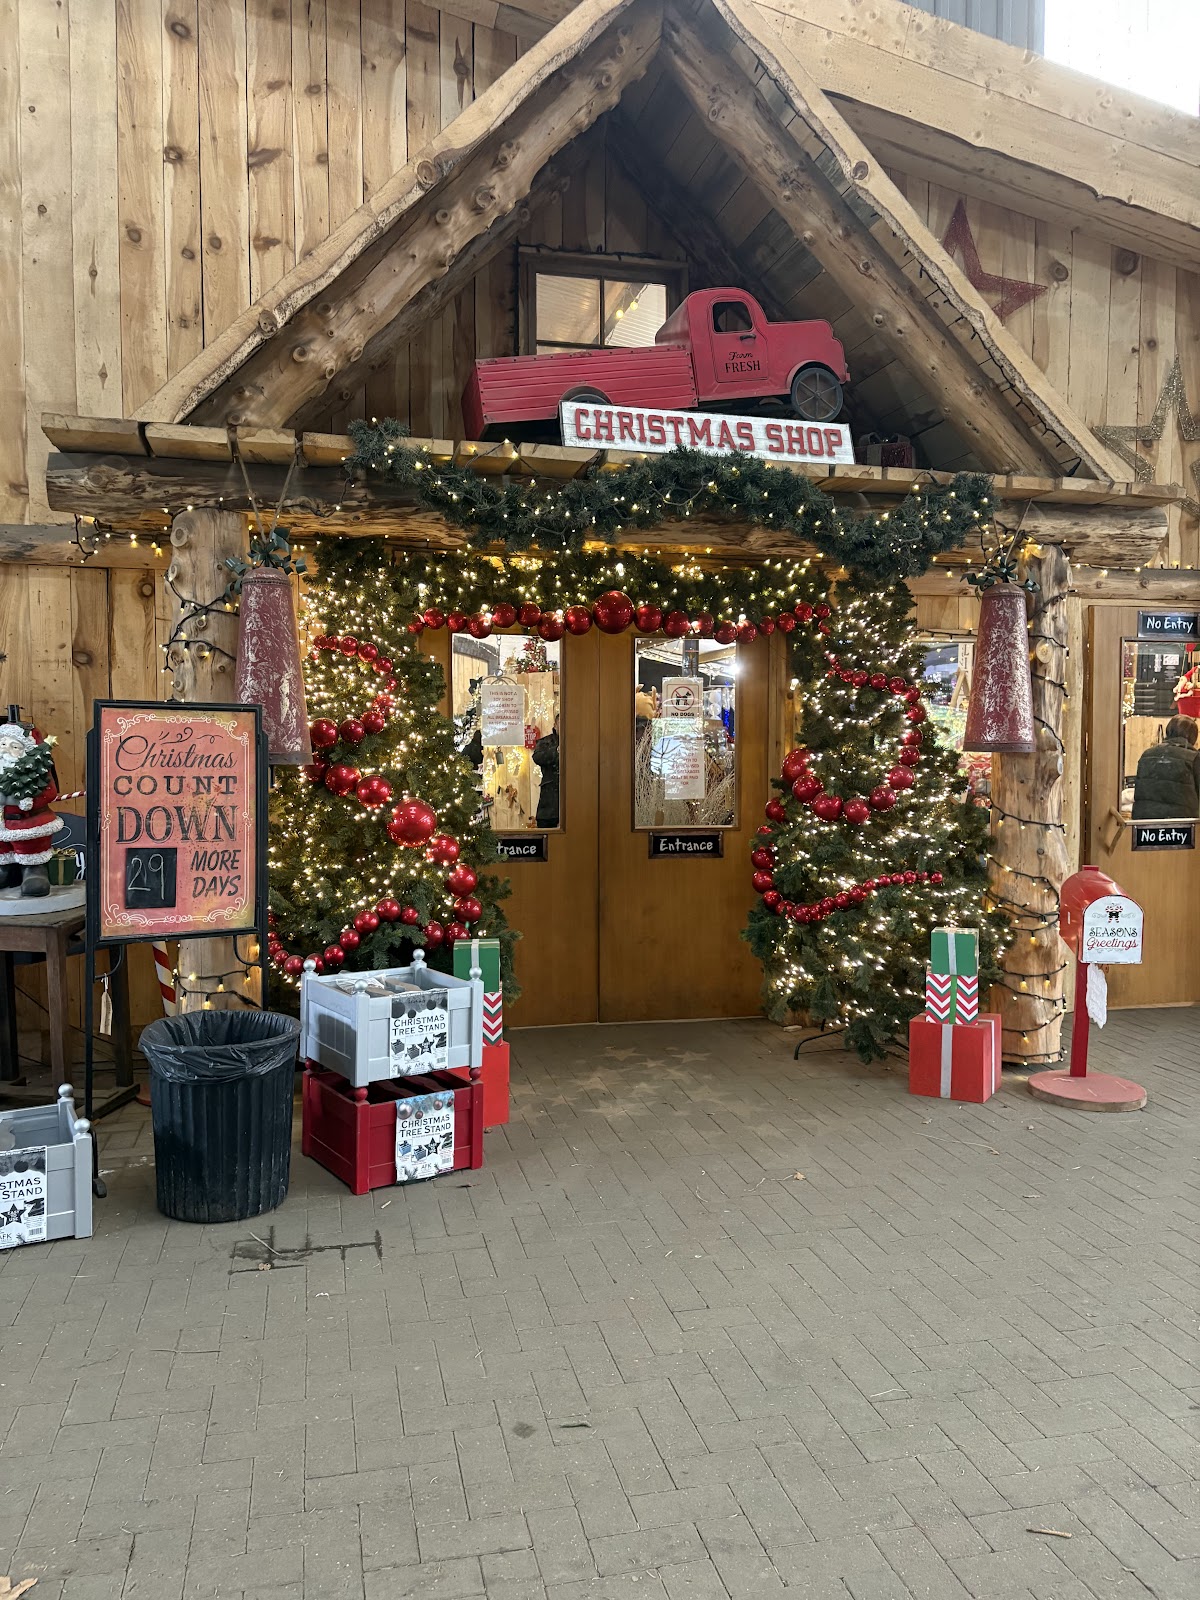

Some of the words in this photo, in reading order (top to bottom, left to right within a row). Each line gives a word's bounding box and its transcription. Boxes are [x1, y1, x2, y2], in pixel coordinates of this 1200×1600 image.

[729, 352, 754, 361] Farm
[725, 360, 761, 373] FRESH
[575, 408, 755, 451] CHRISTMAS
[766, 424, 843, 456] SHOP
[1146, 616, 1162, 629] No
[1164, 617, 1194, 634] Entry
[114, 735, 238, 772] Christmas
[113, 775, 238, 796] COUNT
[116, 804, 240, 844] DOWN
[1141, 829, 1156, 842] No
[1158, 829, 1188, 844] Entry
[496, 842, 537, 855] trance
[659, 838, 713, 852] Entrance
[190, 849, 241, 873] MORE
[128, 853, 165, 900] 29
[192, 875, 241, 898] DAYS
[1089, 926, 1138, 938] SEASONS
[1086, 936, 1138, 951] Greetings
[393, 1014, 445, 1028] CHRISTMAS
[392, 1027, 416, 1036] TREE
[418, 1022, 446, 1033] STAND
[401, 1114, 450, 1129] CHRISTMAS
[400, 1128, 423, 1138] TREE
[424, 1122, 452, 1134] STAND
[0, 1177, 41, 1190] STMAS
[2, 1186, 43, 1200] STAND
